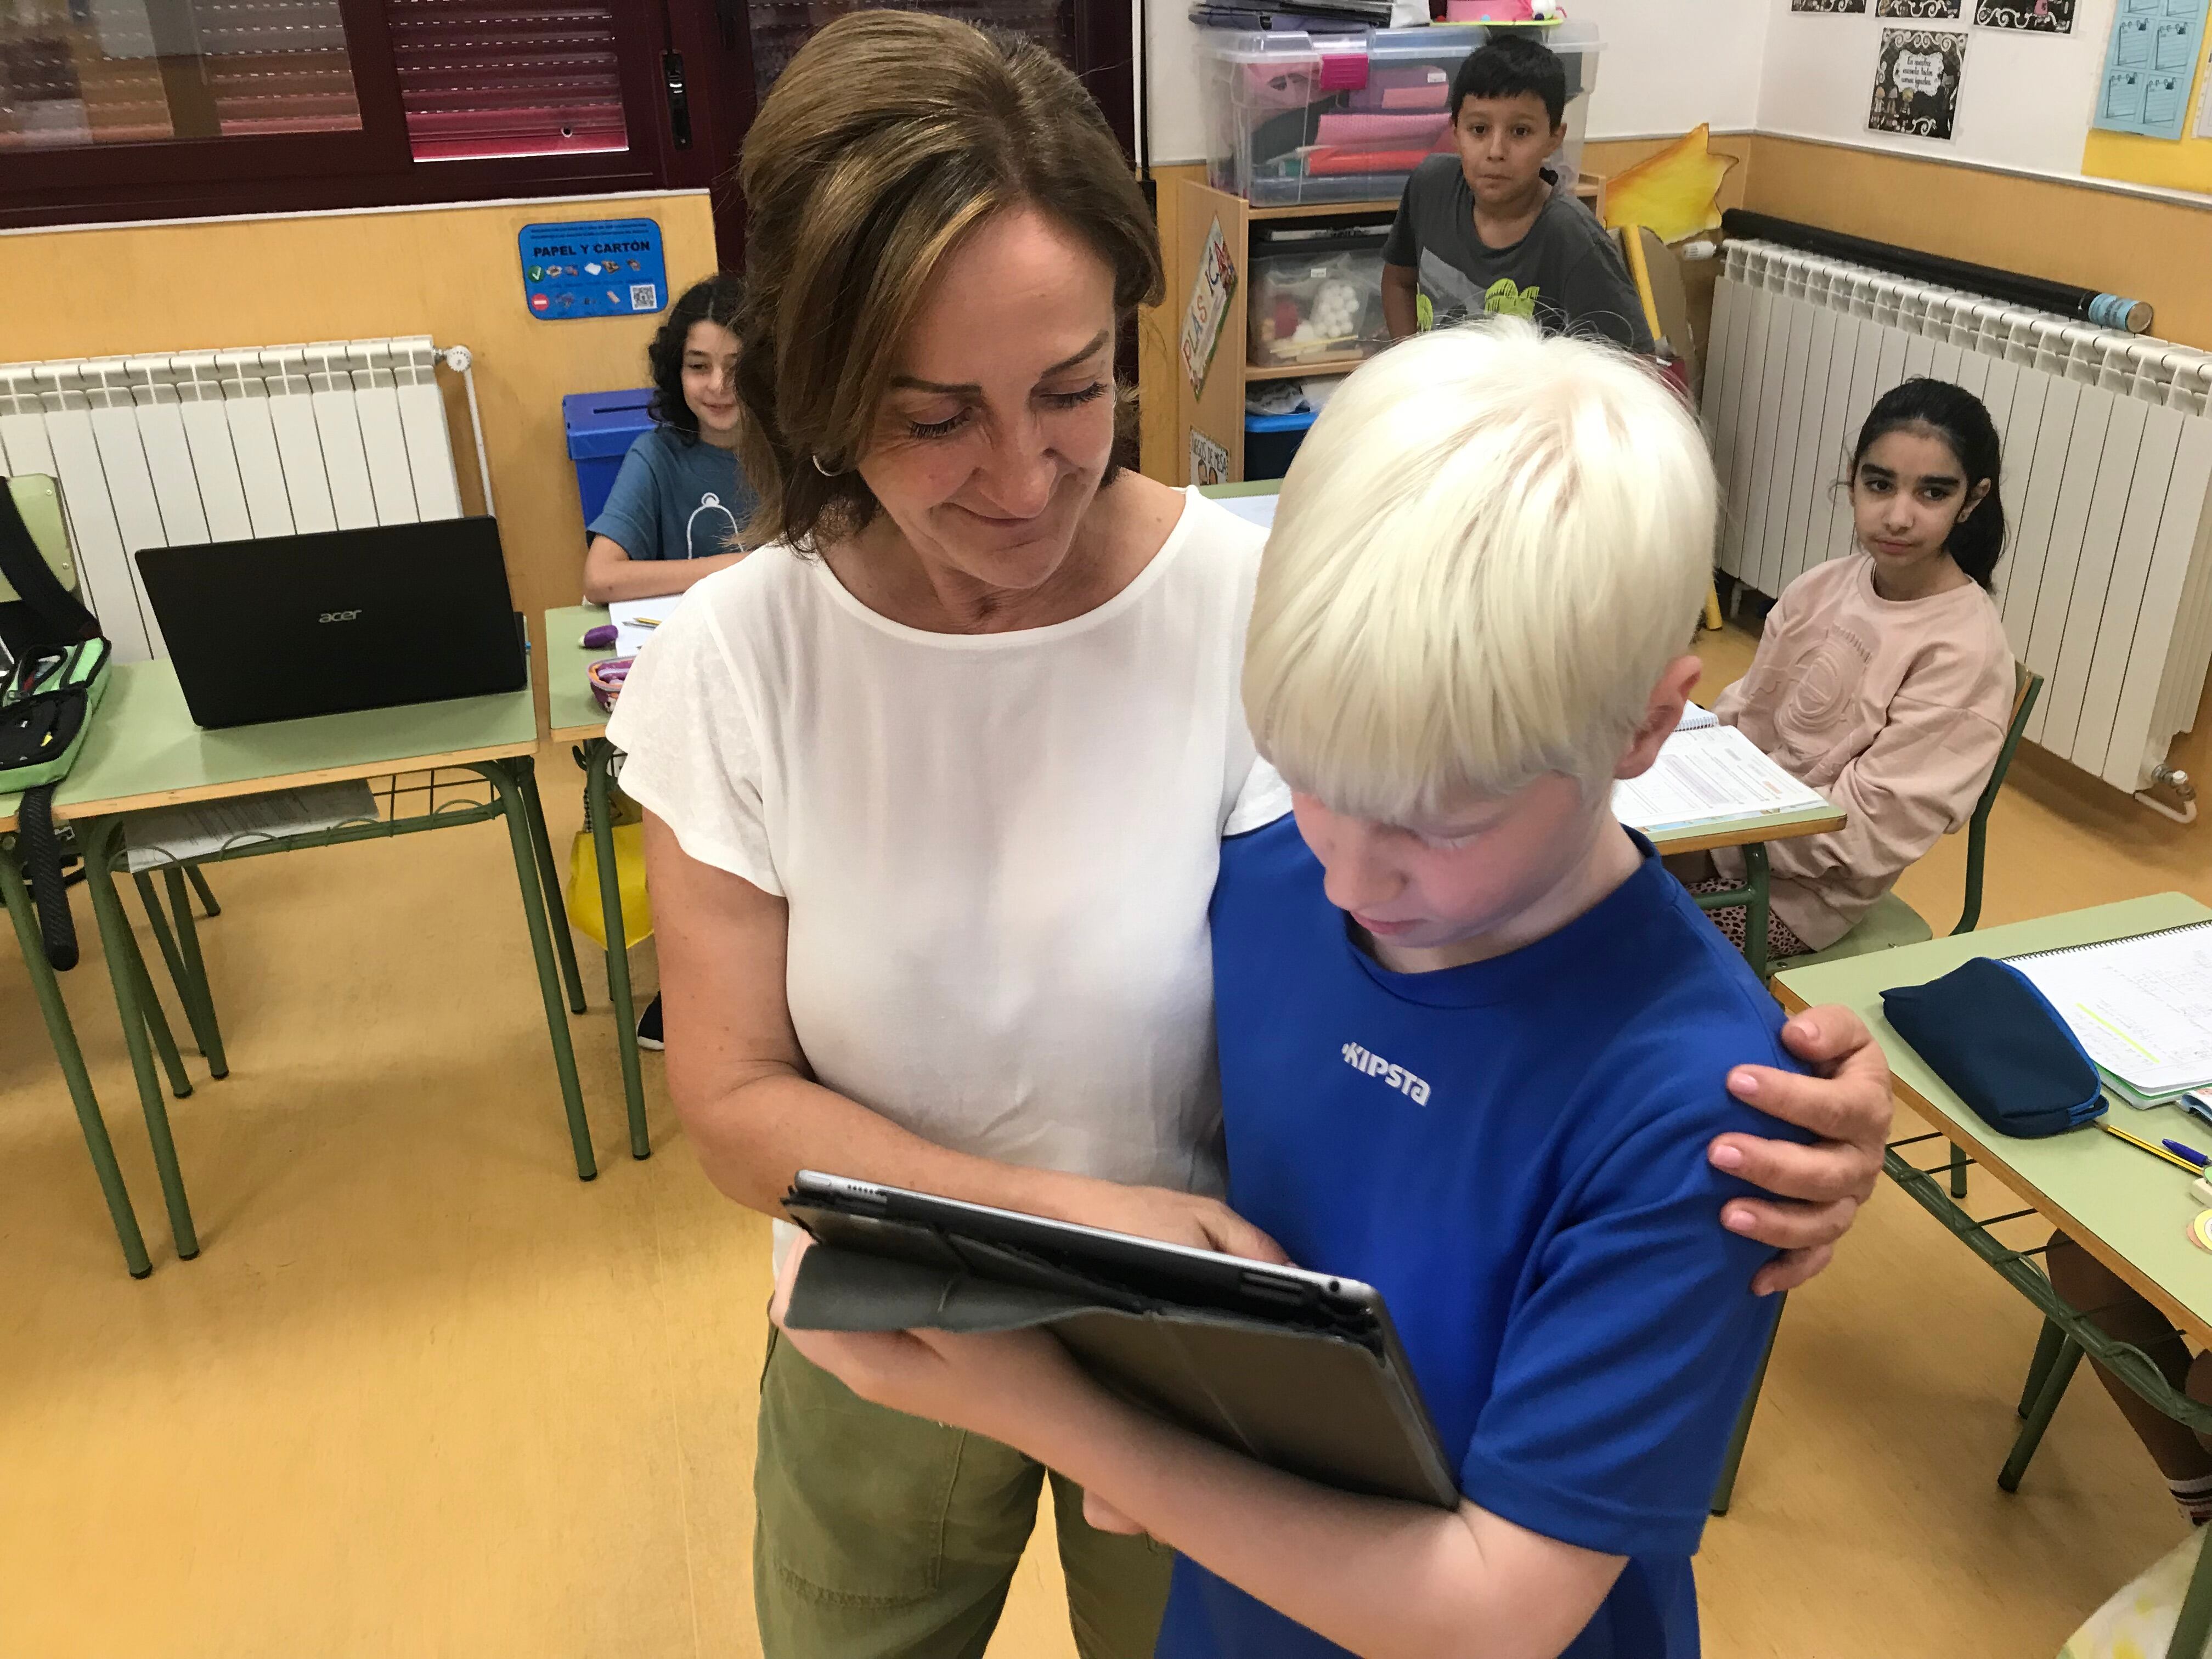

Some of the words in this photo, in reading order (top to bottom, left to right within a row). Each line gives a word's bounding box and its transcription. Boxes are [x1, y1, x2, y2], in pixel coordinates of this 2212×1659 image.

[534, 245, 575, 257] PAPEL
[580, 244, 590, 254] Y
[593, 240, 650, 253] CARTÓN
[318, 609, 363, 623] acer
